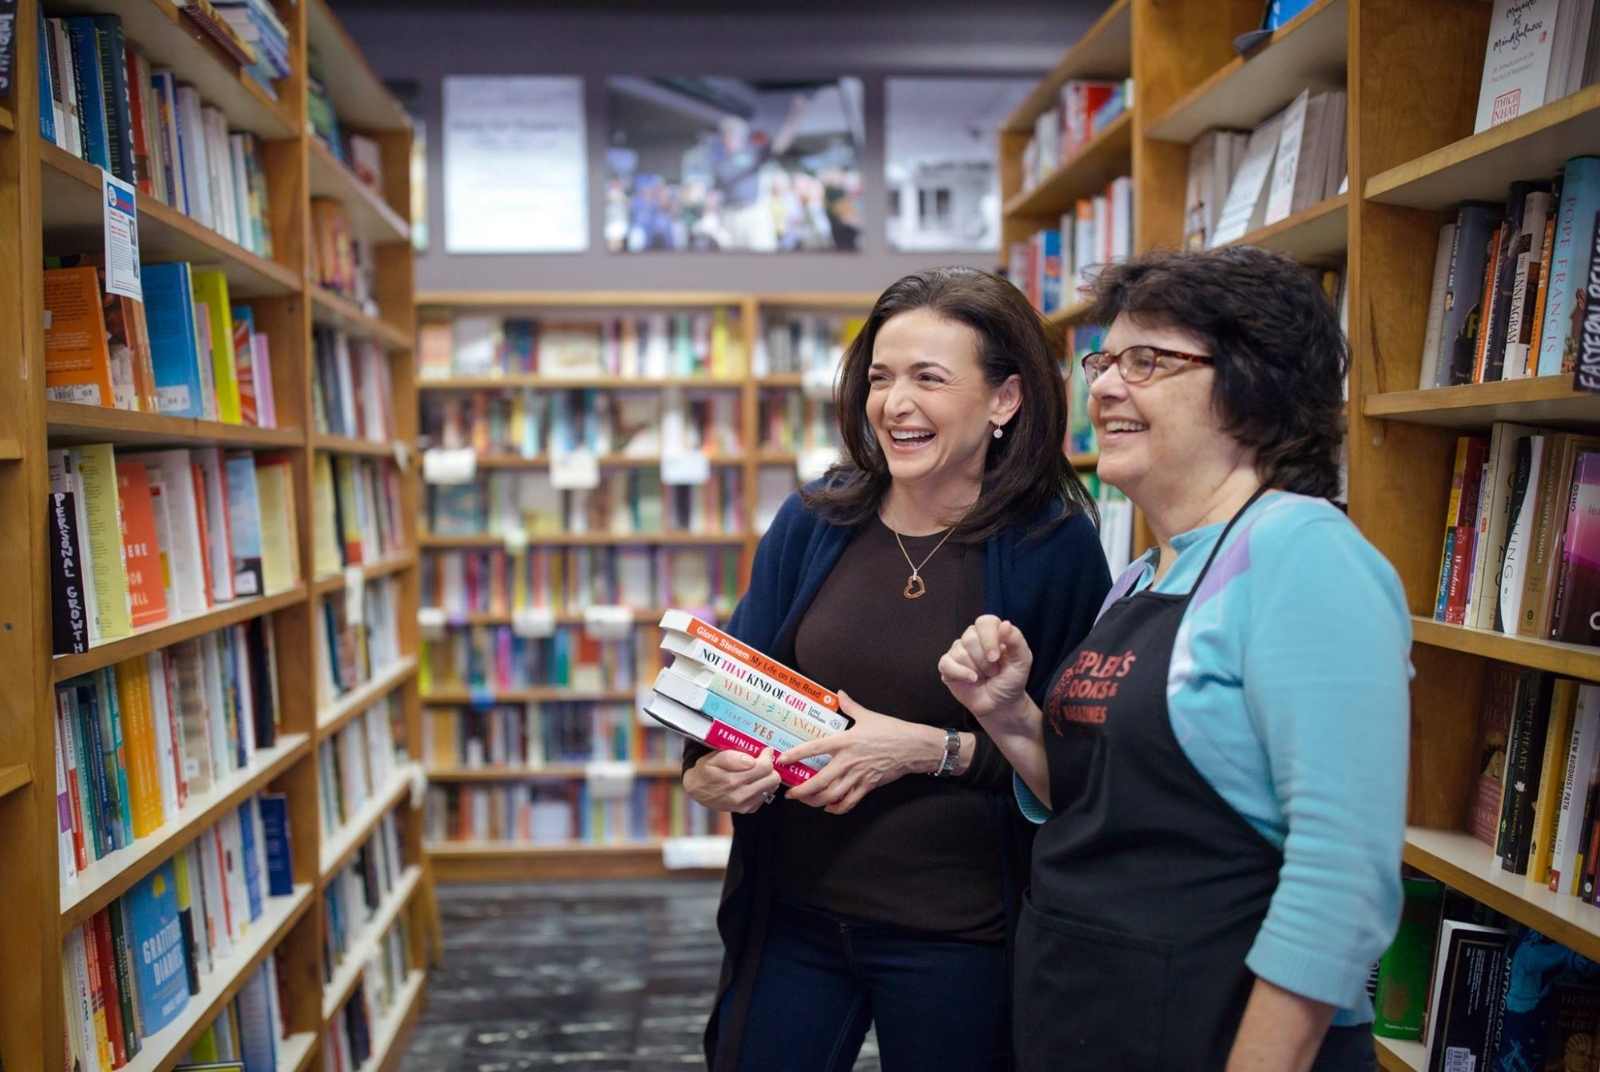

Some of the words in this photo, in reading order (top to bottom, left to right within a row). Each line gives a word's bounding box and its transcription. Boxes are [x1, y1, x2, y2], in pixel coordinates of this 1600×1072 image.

[1560, 197, 1577, 247] POPE
[1506, 271, 1525, 344] ENNEAGRAM
[1546, 257, 1568, 353] FRANCIS
[1570, 484, 1579, 512] OSHO
[54, 492, 75, 578] PERSONAL
[66, 586, 84, 653] GROWTH
[1450, 554, 1463, 597] Wisdom
[696, 626, 718, 643] Gloria
[719, 638, 750, 660] Steinem
[802, 682, 822, 699] Road
[702, 648, 721, 665] NOT
[720, 659, 746, 680] THAT
[746, 672, 771, 697] KIND
[771, 687, 785, 700] OF
[784, 693, 808, 713] GIRL
[752, 721, 775, 741] YES
[793, 715, 828, 739] ANGELO
[716, 728, 760, 754] FEMINIST
[789, 764, 811, 780] CLUB
[1562, 793, 1572, 811] PATH
[1495, 957, 1513, 1052] MYTHOLOGY
